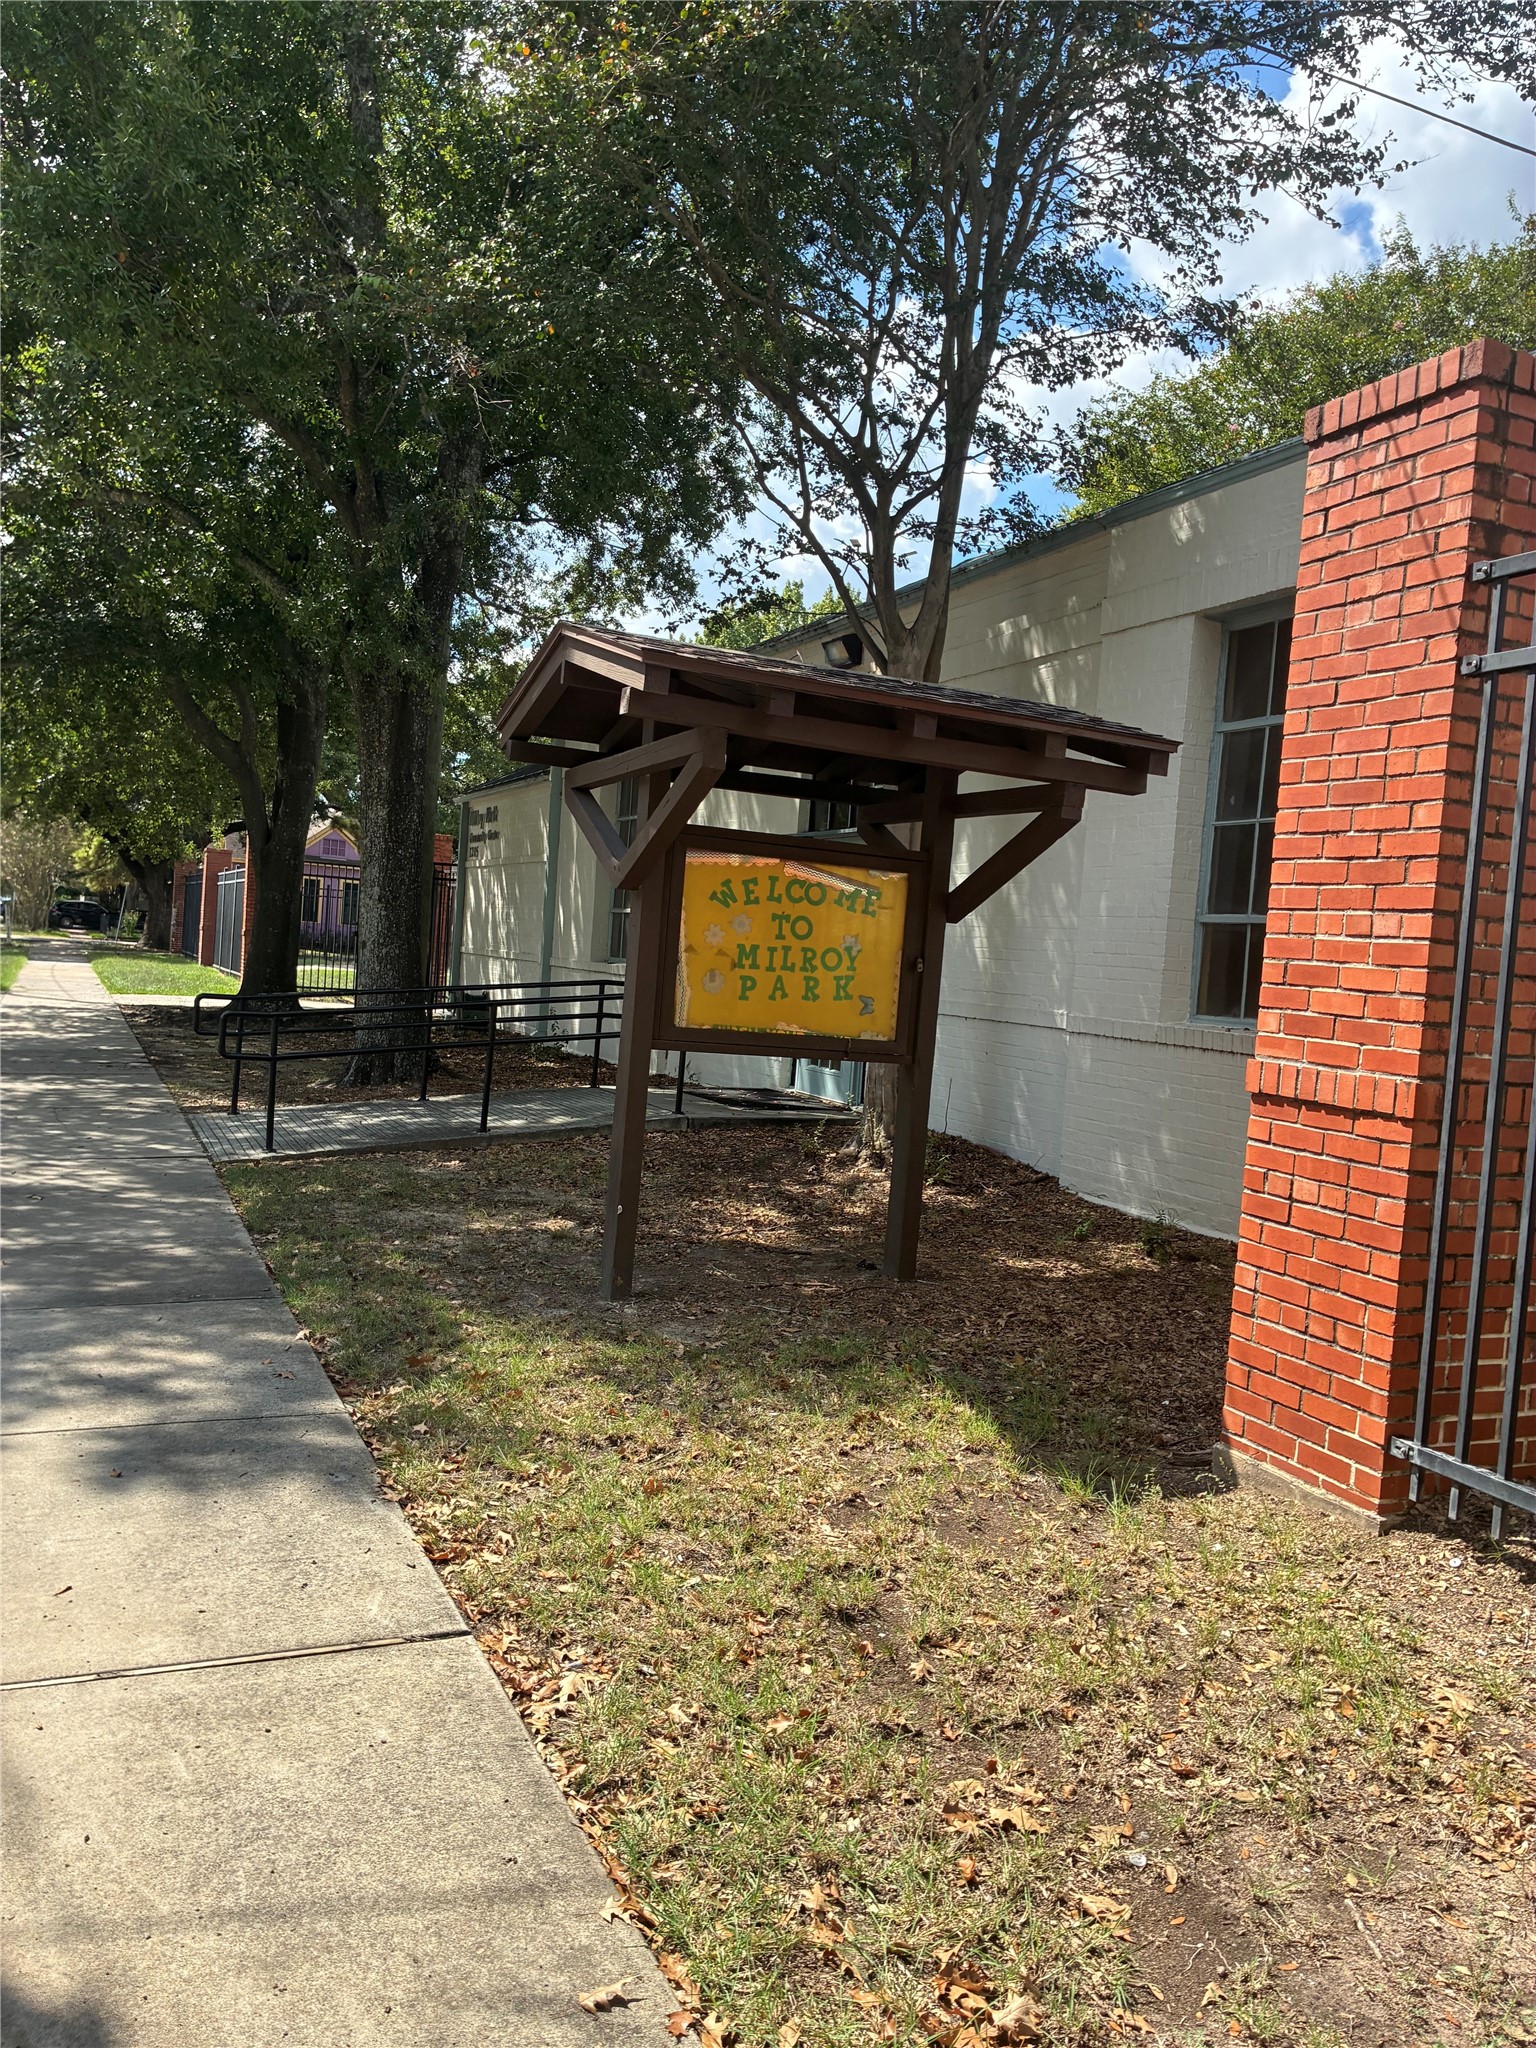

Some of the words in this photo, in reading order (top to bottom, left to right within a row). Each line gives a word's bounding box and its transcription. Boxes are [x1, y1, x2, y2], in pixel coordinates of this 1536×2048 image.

[709, 876, 882, 918] WELCOME
[771, 913, 813, 940] TO
[737, 943, 862, 974] MILROY
[739, 974, 855, 1002] PARK
